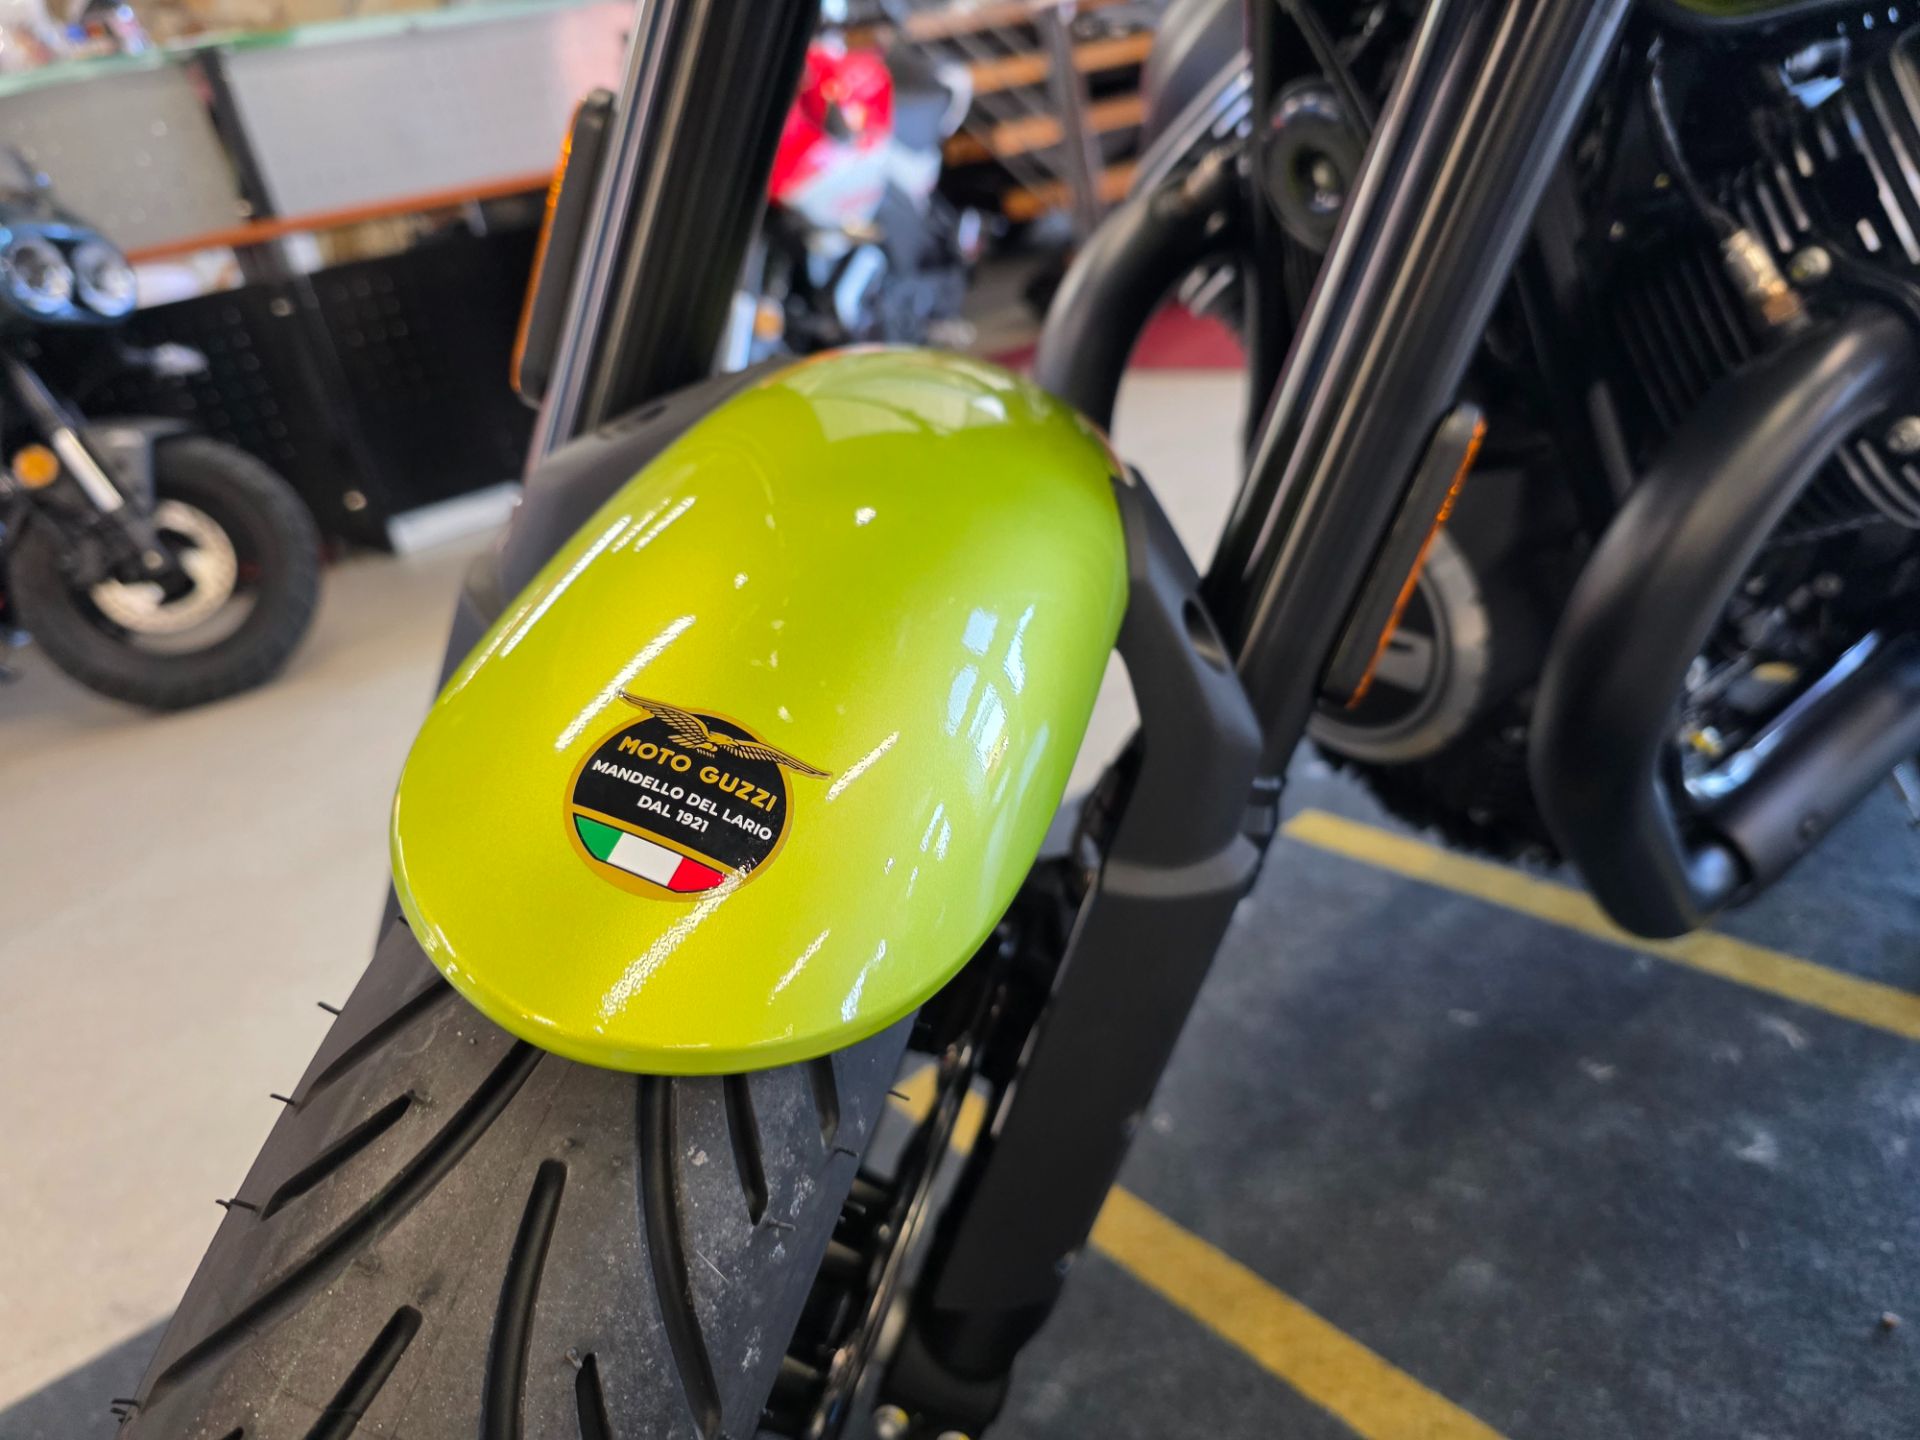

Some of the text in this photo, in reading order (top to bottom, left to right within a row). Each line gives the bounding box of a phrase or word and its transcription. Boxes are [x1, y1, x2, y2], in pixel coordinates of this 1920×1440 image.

[591, 759, 772, 841] MANDELLO DEL LARIO
[617, 735, 778, 812] MOTO GUZZI
[637, 795, 710, 833] DAL 1921
